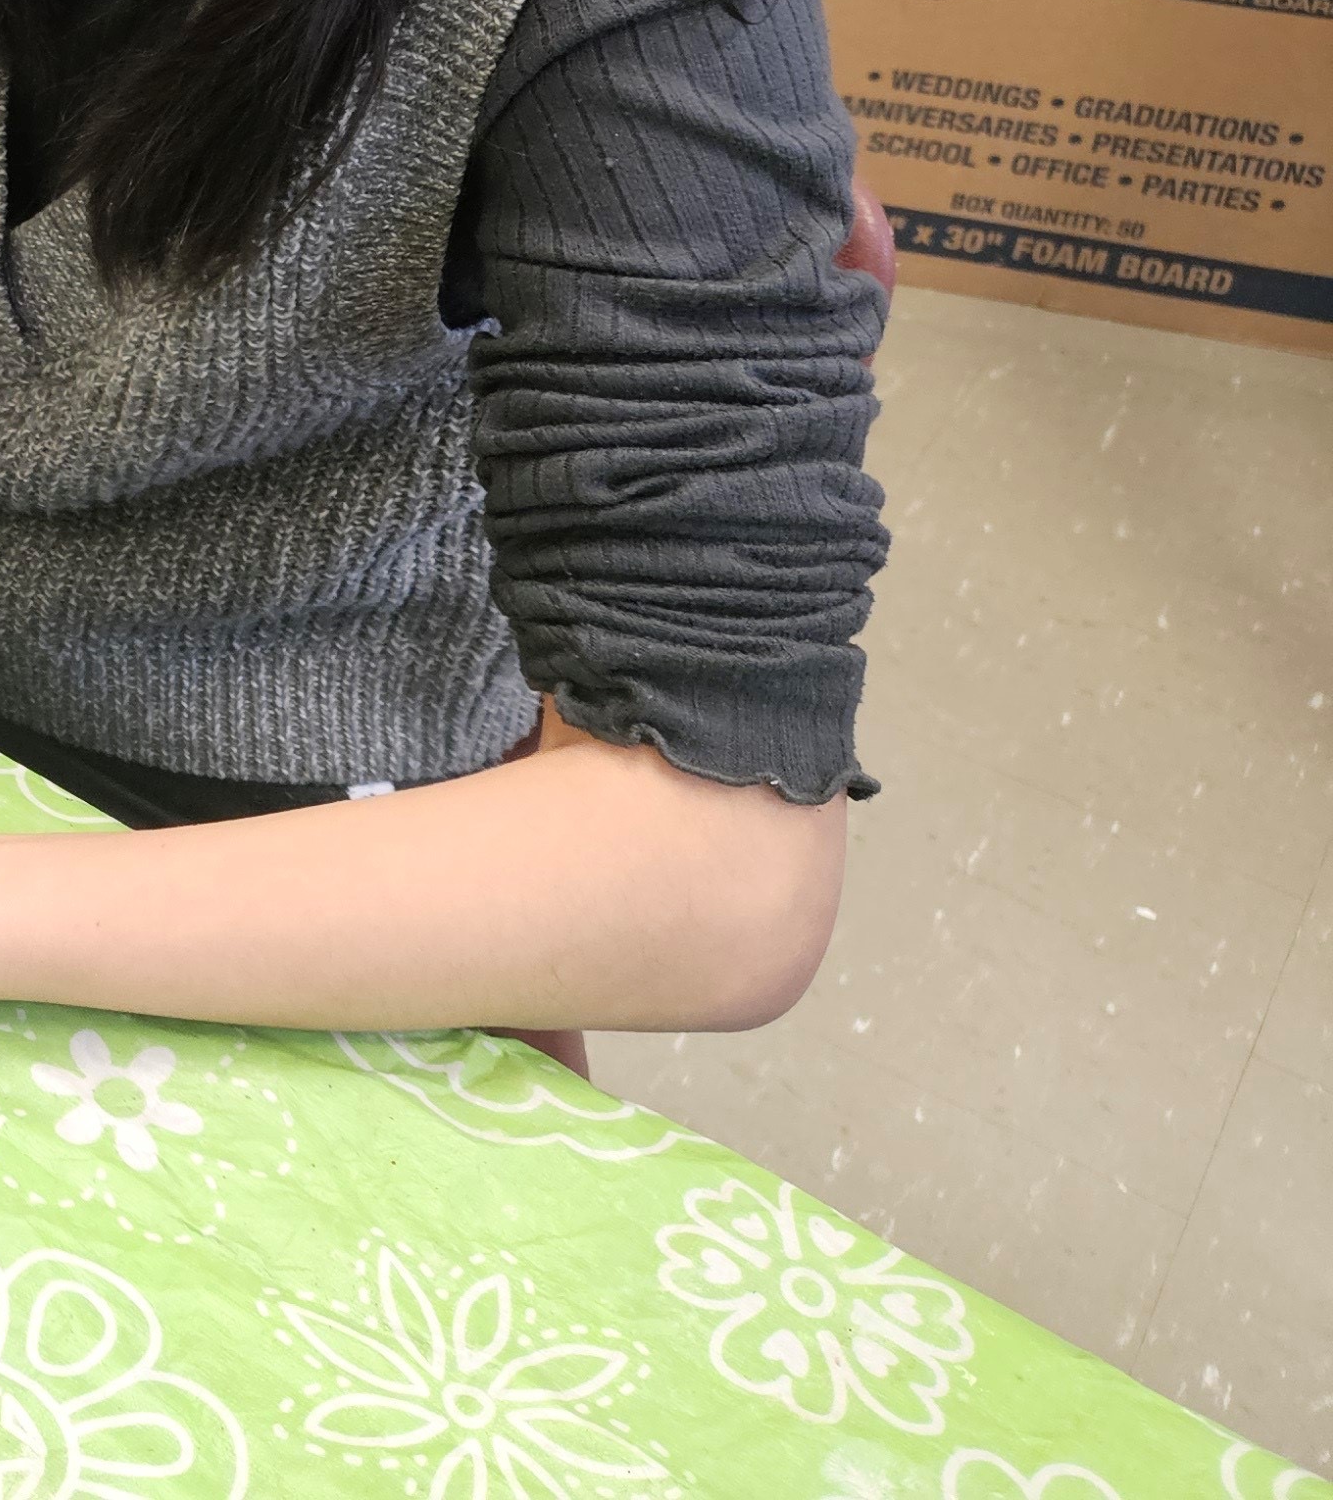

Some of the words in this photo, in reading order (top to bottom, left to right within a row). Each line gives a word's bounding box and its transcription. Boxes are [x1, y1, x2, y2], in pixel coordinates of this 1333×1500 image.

[891, 68, 1041, 111] WEDDINGS
[1074, 95, 1280, 147] GRADUATIONS
[867, 131, 975, 169] SCHOOL
[1011, 153, 1110, 189] OFFICE
[1140, 173, 1261, 213] PARTIES
[1091, 132, 1326, 189] PRESENTATIONS
[950, 192, 996, 215] BOX
[942, 225, 1004, 254] 30"
[1011, 236, 1110, 277] FOAM
[1117, 252, 1234, 297] BOARD
